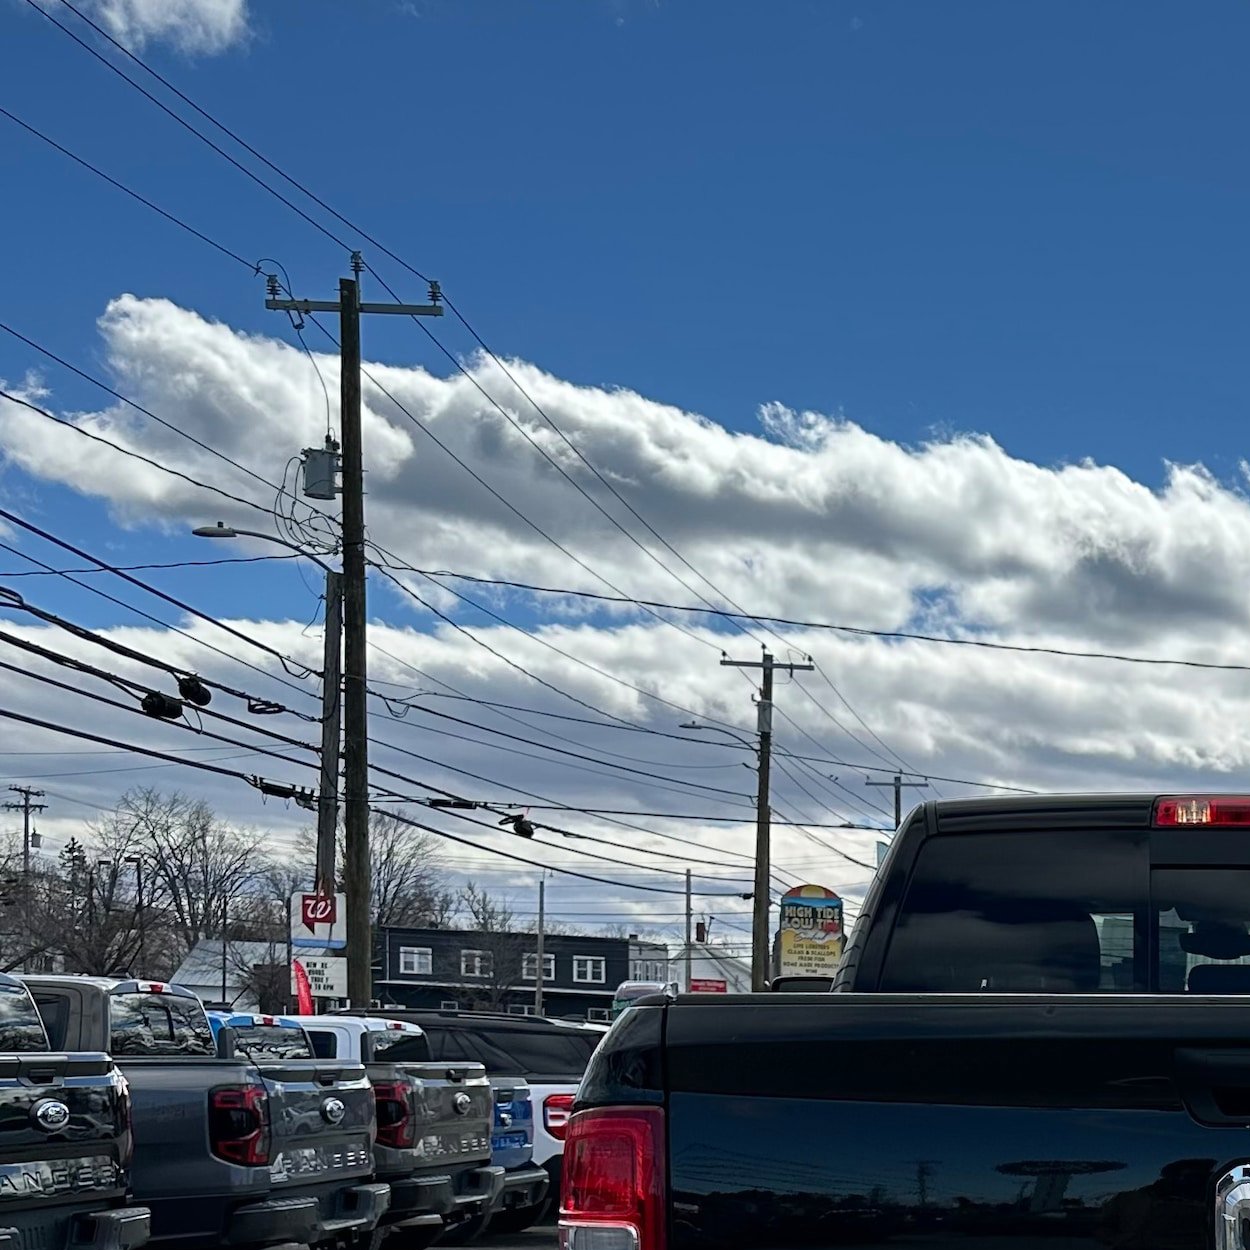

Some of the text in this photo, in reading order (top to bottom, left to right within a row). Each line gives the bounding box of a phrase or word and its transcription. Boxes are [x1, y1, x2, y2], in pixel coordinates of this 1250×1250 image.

[784, 906, 840, 919] HIGH TIDE
[782, 918, 840, 931] LOW TI
[0, 1165, 116, 1194] ANGER
